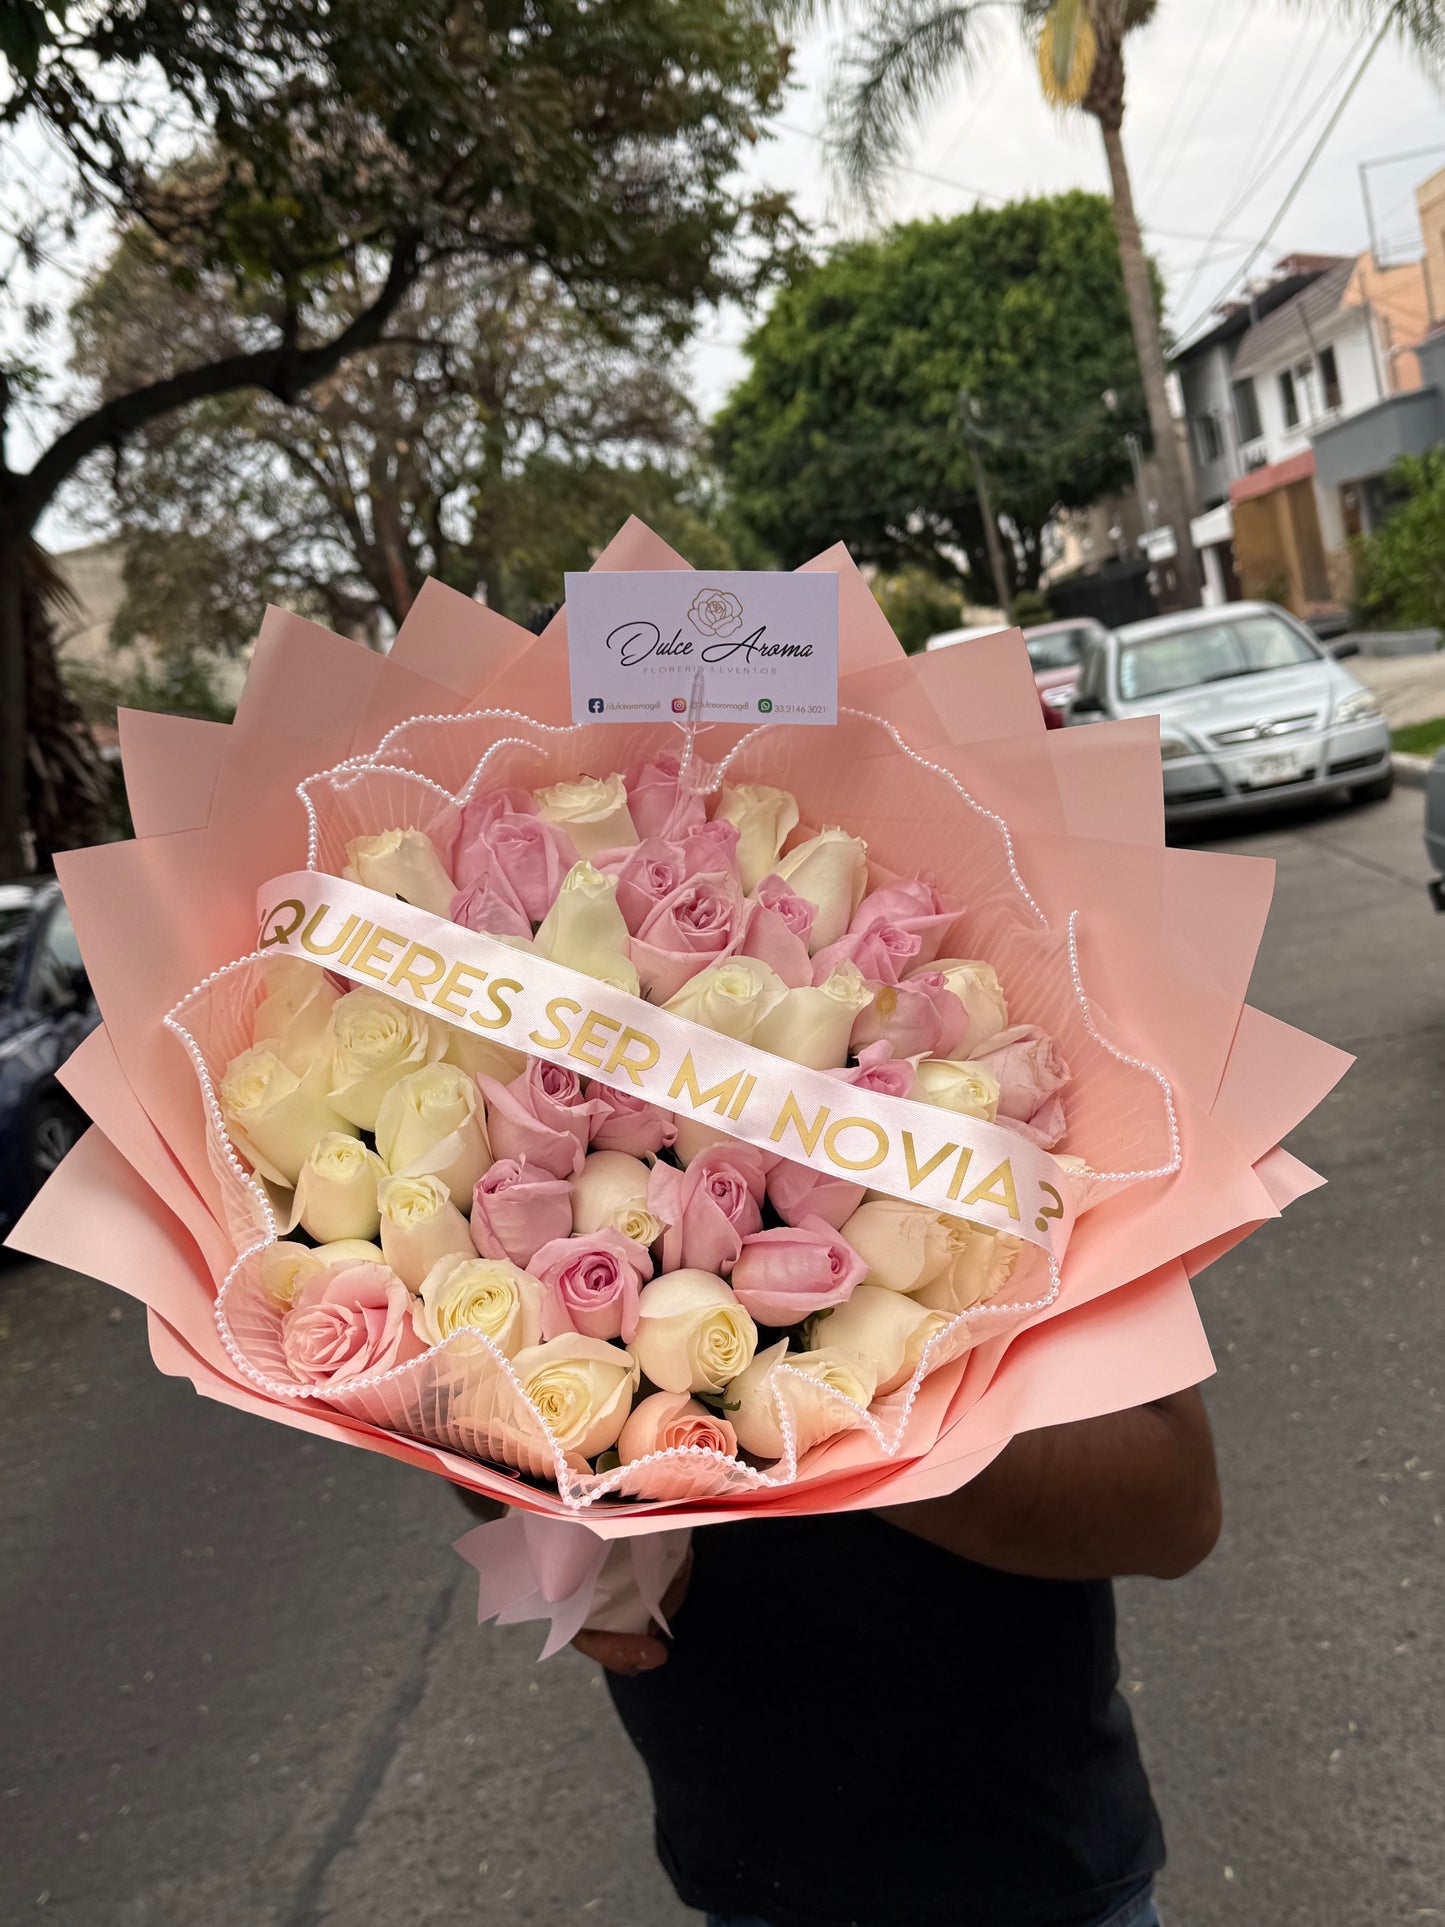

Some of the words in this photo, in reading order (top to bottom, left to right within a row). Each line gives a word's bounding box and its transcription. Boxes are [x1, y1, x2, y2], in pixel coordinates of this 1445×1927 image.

[606, 621, 694, 667] Dulce
[701, 625, 814, 664] Aroma
[719, 666, 777, 675] EVENTOS
[529, 995, 661, 1088] SER
[667, 1048, 757, 1120] MI
